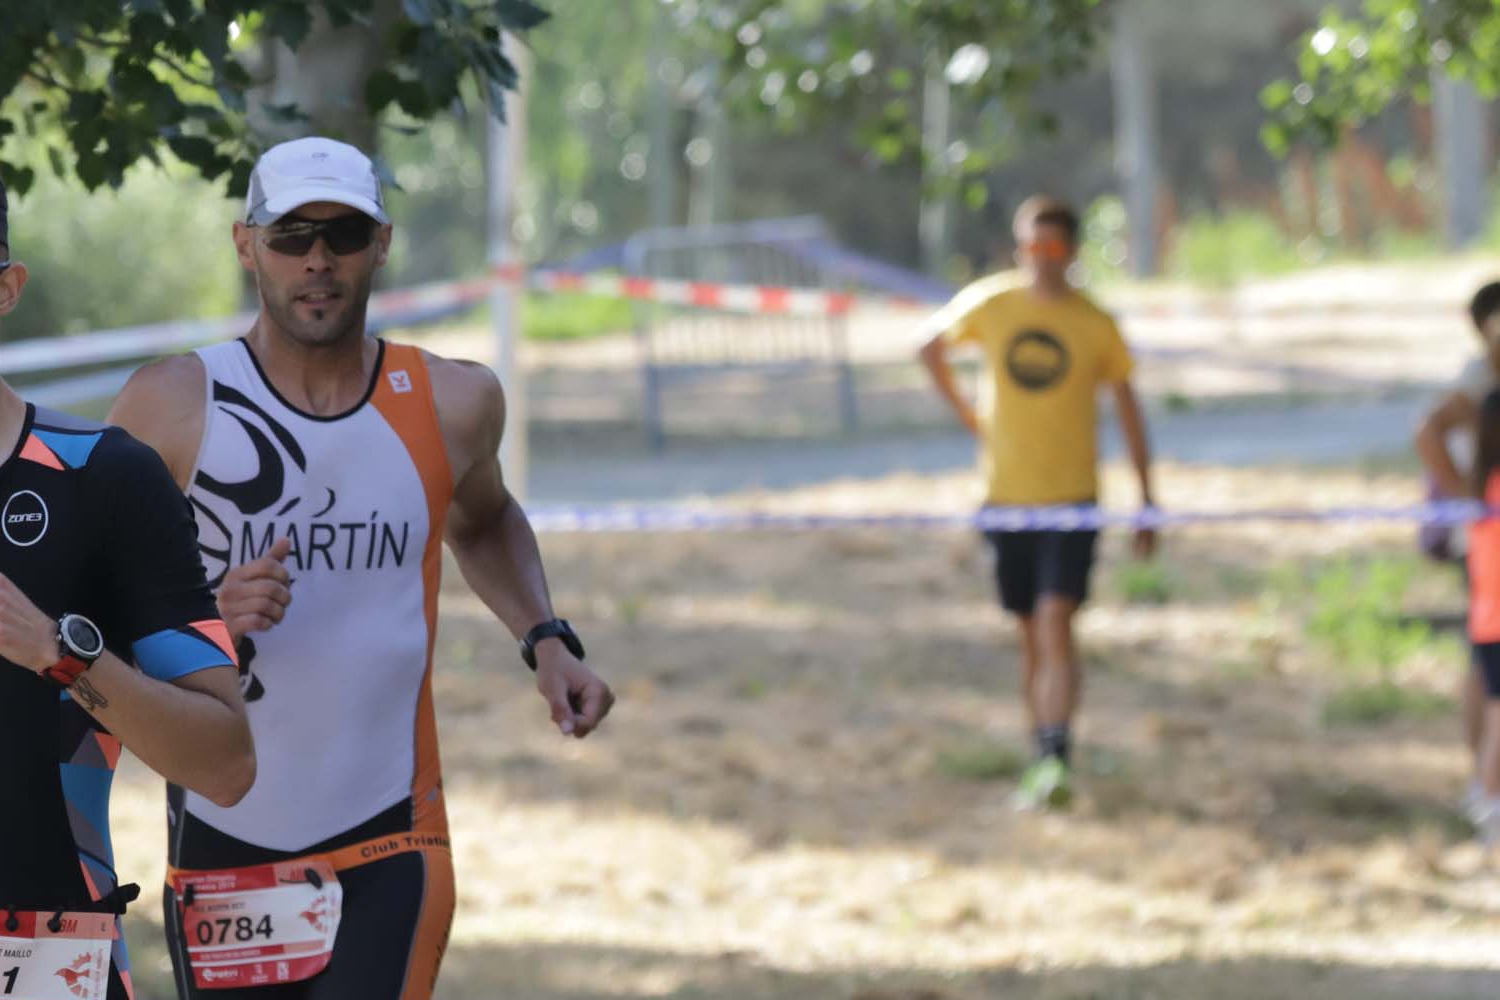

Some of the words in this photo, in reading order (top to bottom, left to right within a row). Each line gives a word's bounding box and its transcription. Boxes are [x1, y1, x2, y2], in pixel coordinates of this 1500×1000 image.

[238, 510, 409, 571] MARTÍN
[361, 840, 399, 857] Club
[196, 914, 274, 945] 0784
[3, 949, 32, 958] MAILLO
